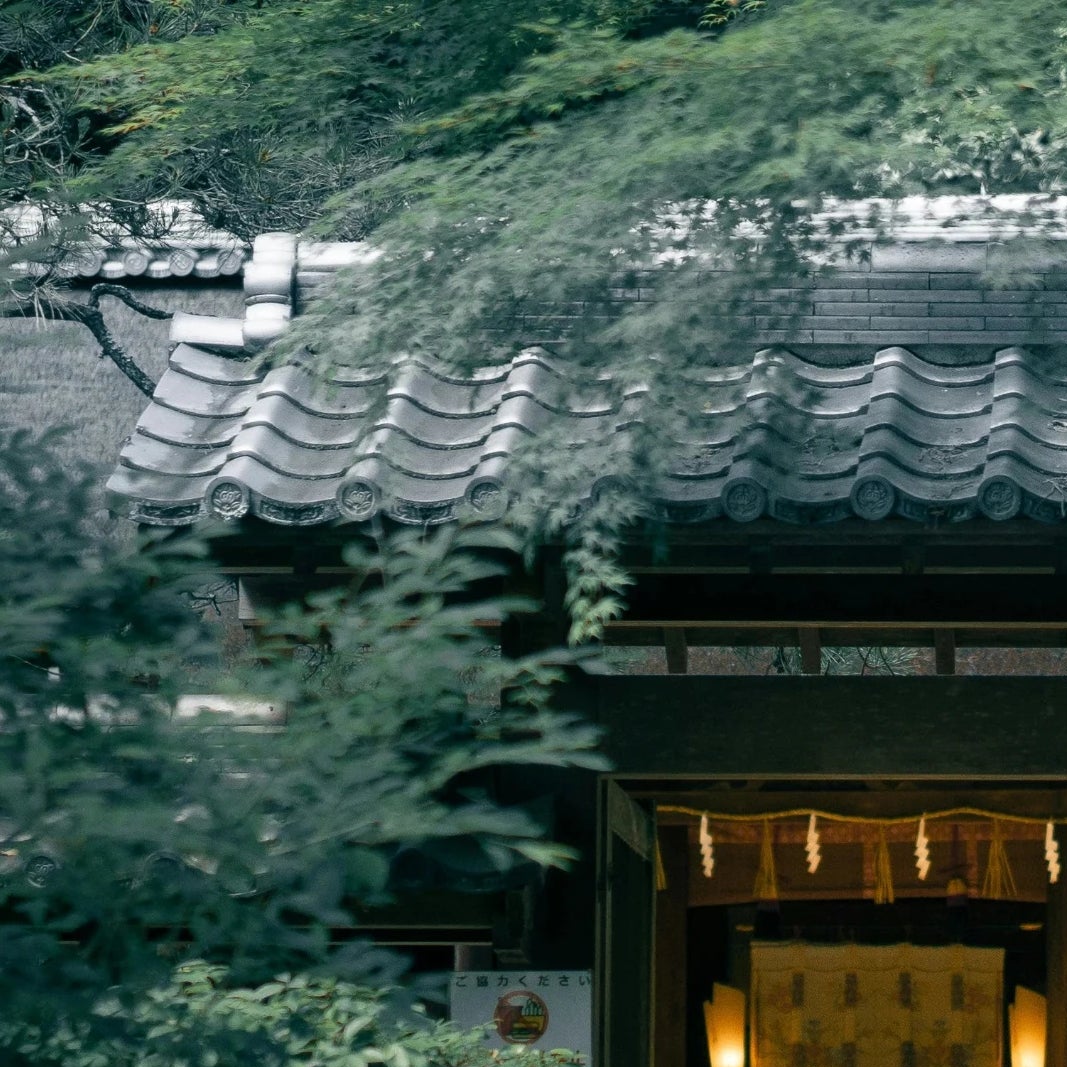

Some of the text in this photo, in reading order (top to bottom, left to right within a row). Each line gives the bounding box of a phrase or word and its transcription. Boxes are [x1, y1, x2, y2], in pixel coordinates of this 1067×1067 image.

[456, 975, 590, 987] ご協力ください
